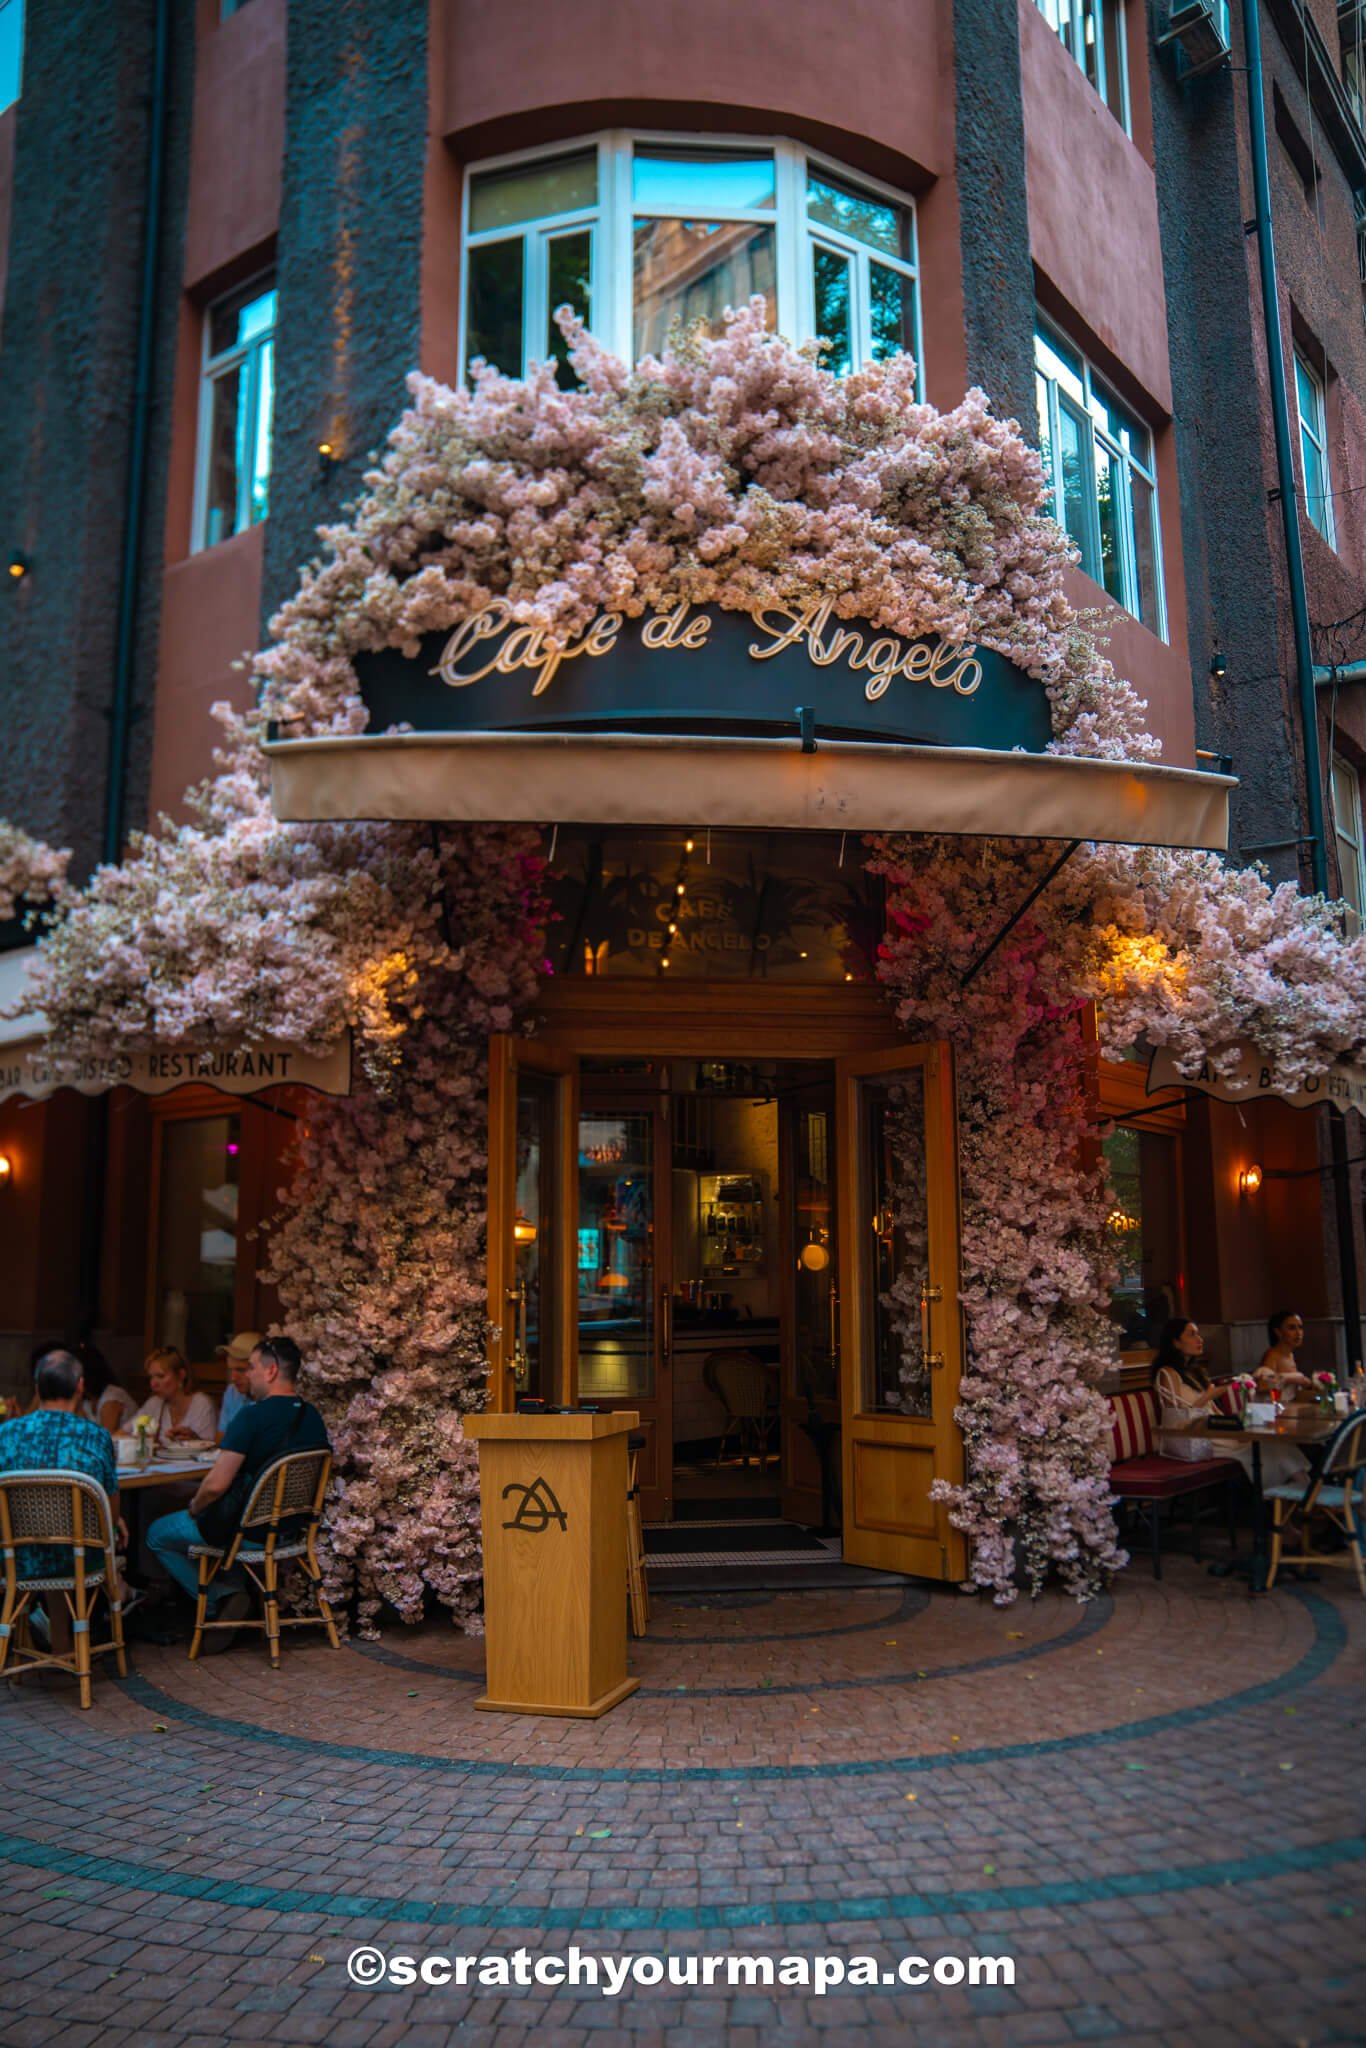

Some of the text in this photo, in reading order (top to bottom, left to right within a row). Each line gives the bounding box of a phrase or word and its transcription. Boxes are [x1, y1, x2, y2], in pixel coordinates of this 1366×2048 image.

[642, 603, 712, 649] de
[748, 592, 983, 701] Angelo
[149, 1051, 293, 1078] RESTAURANT
